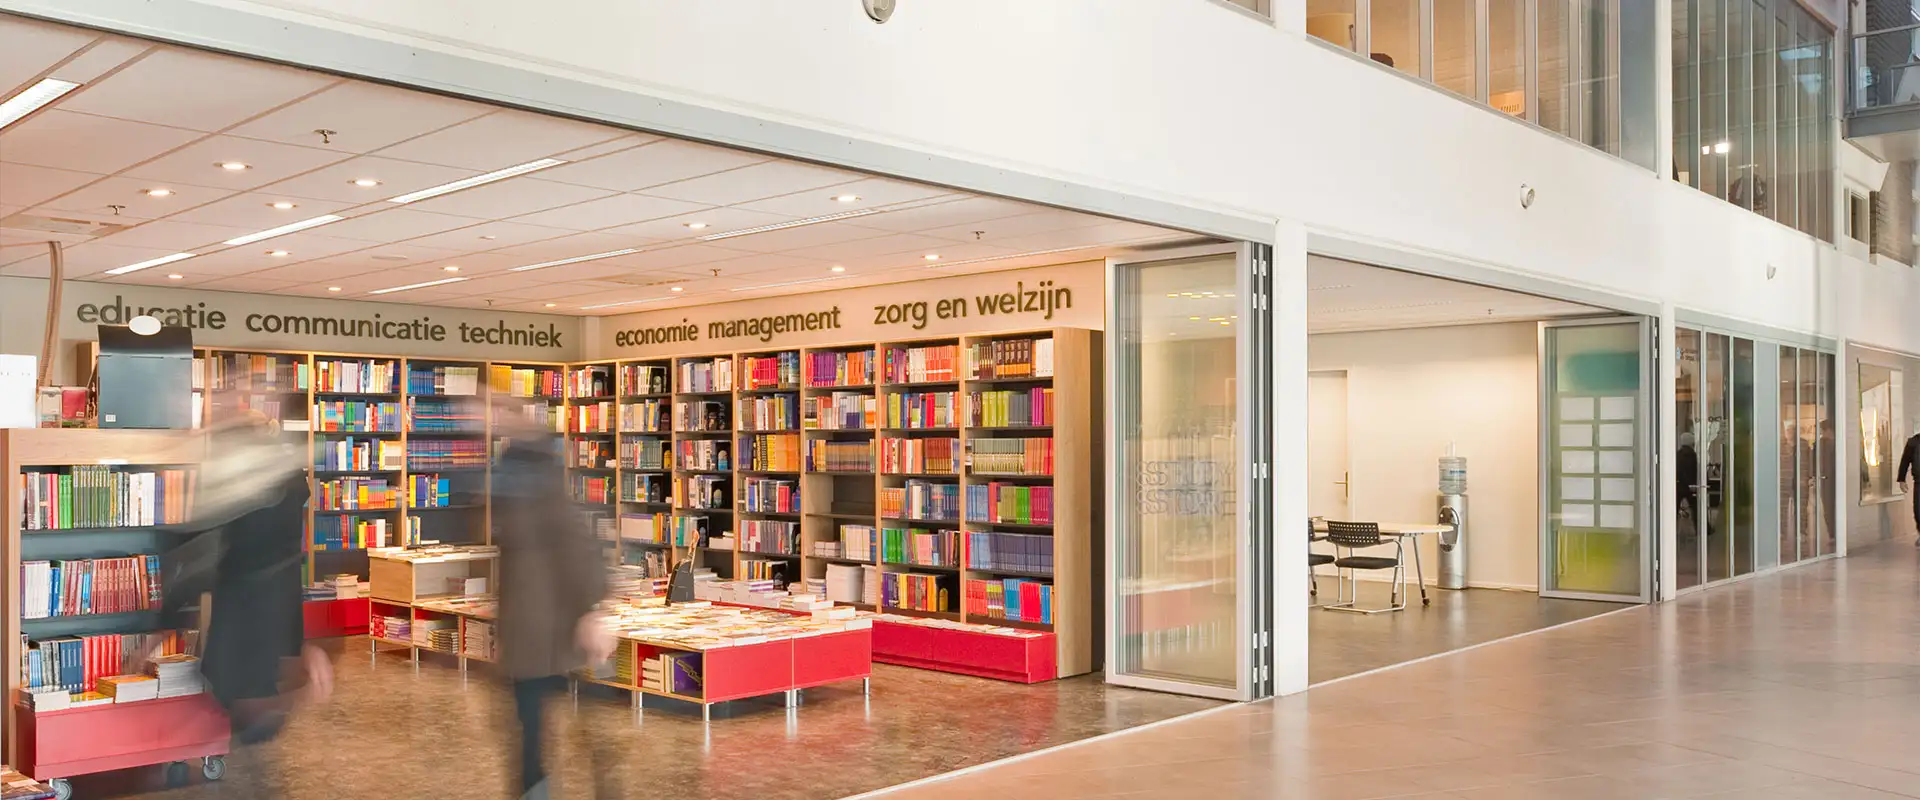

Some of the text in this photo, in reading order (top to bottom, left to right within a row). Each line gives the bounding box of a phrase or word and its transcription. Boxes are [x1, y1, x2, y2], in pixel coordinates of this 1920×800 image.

[874, 280, 1072, 330] zorg en welzijn
[246, 313, 446, 341] communicatie
[459, 320, 563, 348] techniek
[616, 306, 841, 347] economie management
